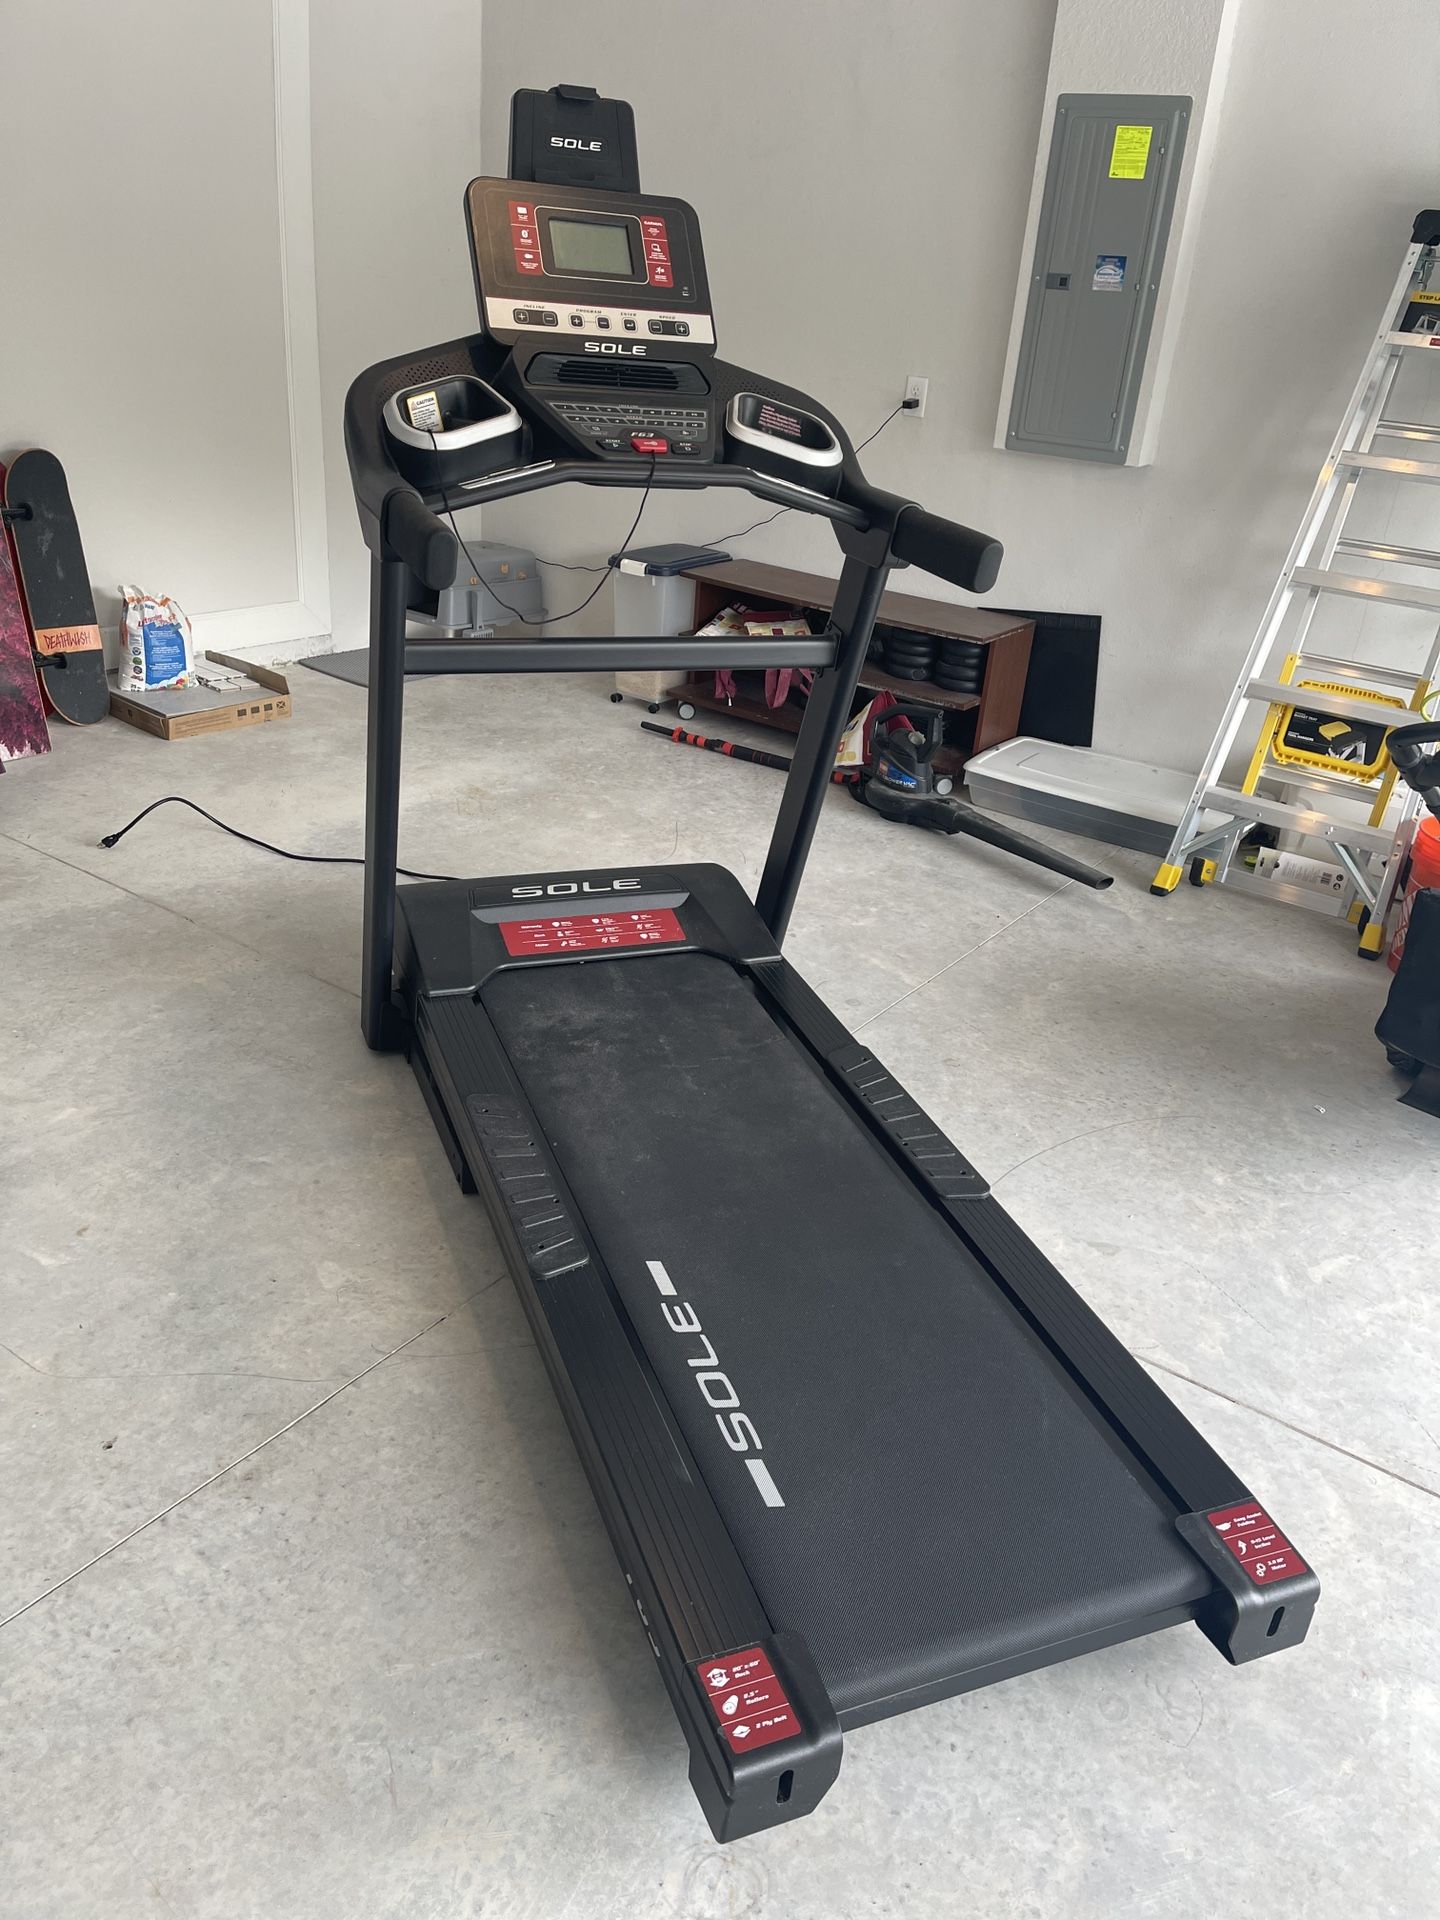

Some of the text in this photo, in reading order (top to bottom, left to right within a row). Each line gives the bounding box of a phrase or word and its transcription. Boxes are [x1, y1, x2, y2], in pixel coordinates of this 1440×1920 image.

[550, 136, 603, 152] SOLE
[584, 341, 648, 356] SOLE
[43, 631, 91, 649] DEATHWISH
[511, 878, 642, 898] SOLE
[660, 1302, 763, 1452] SOLE
[734, 1670, 751, 1679] Deck
[745, 1694, 770, 1705] Rollers
